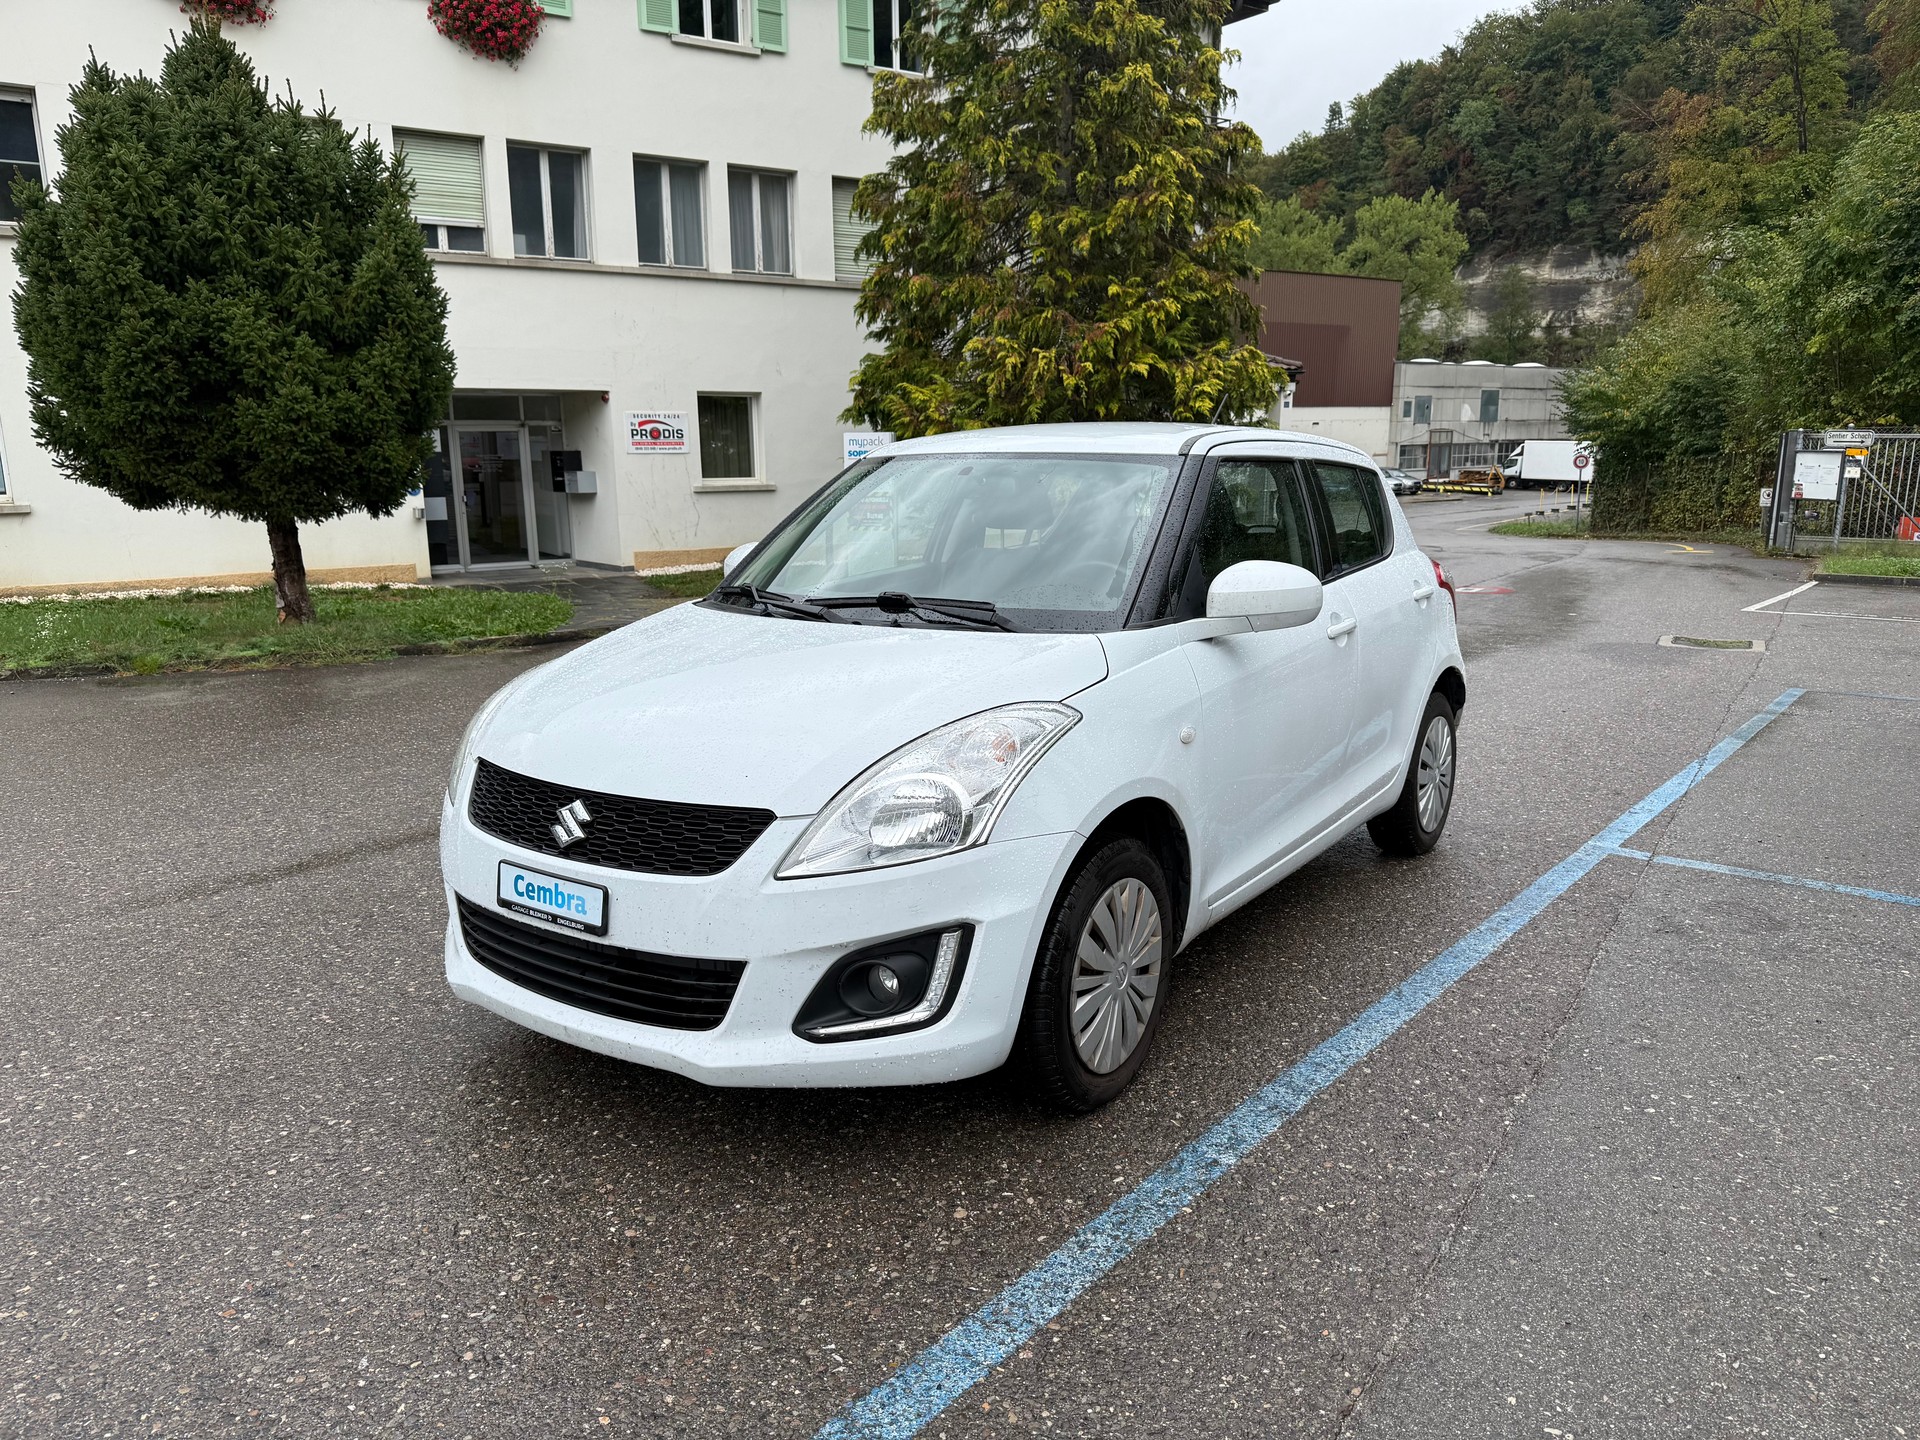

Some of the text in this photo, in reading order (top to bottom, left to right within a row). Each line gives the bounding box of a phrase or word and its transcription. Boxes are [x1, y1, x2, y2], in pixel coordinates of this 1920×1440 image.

[630, 427, 684, 440] PRODIS
[848, 436, 884, 448] mypack
[513, 874, 587, 916] Cembra
[511, 904, 530, 915] GARAGE
[557, 917, 585, 931] ENGELBURG
